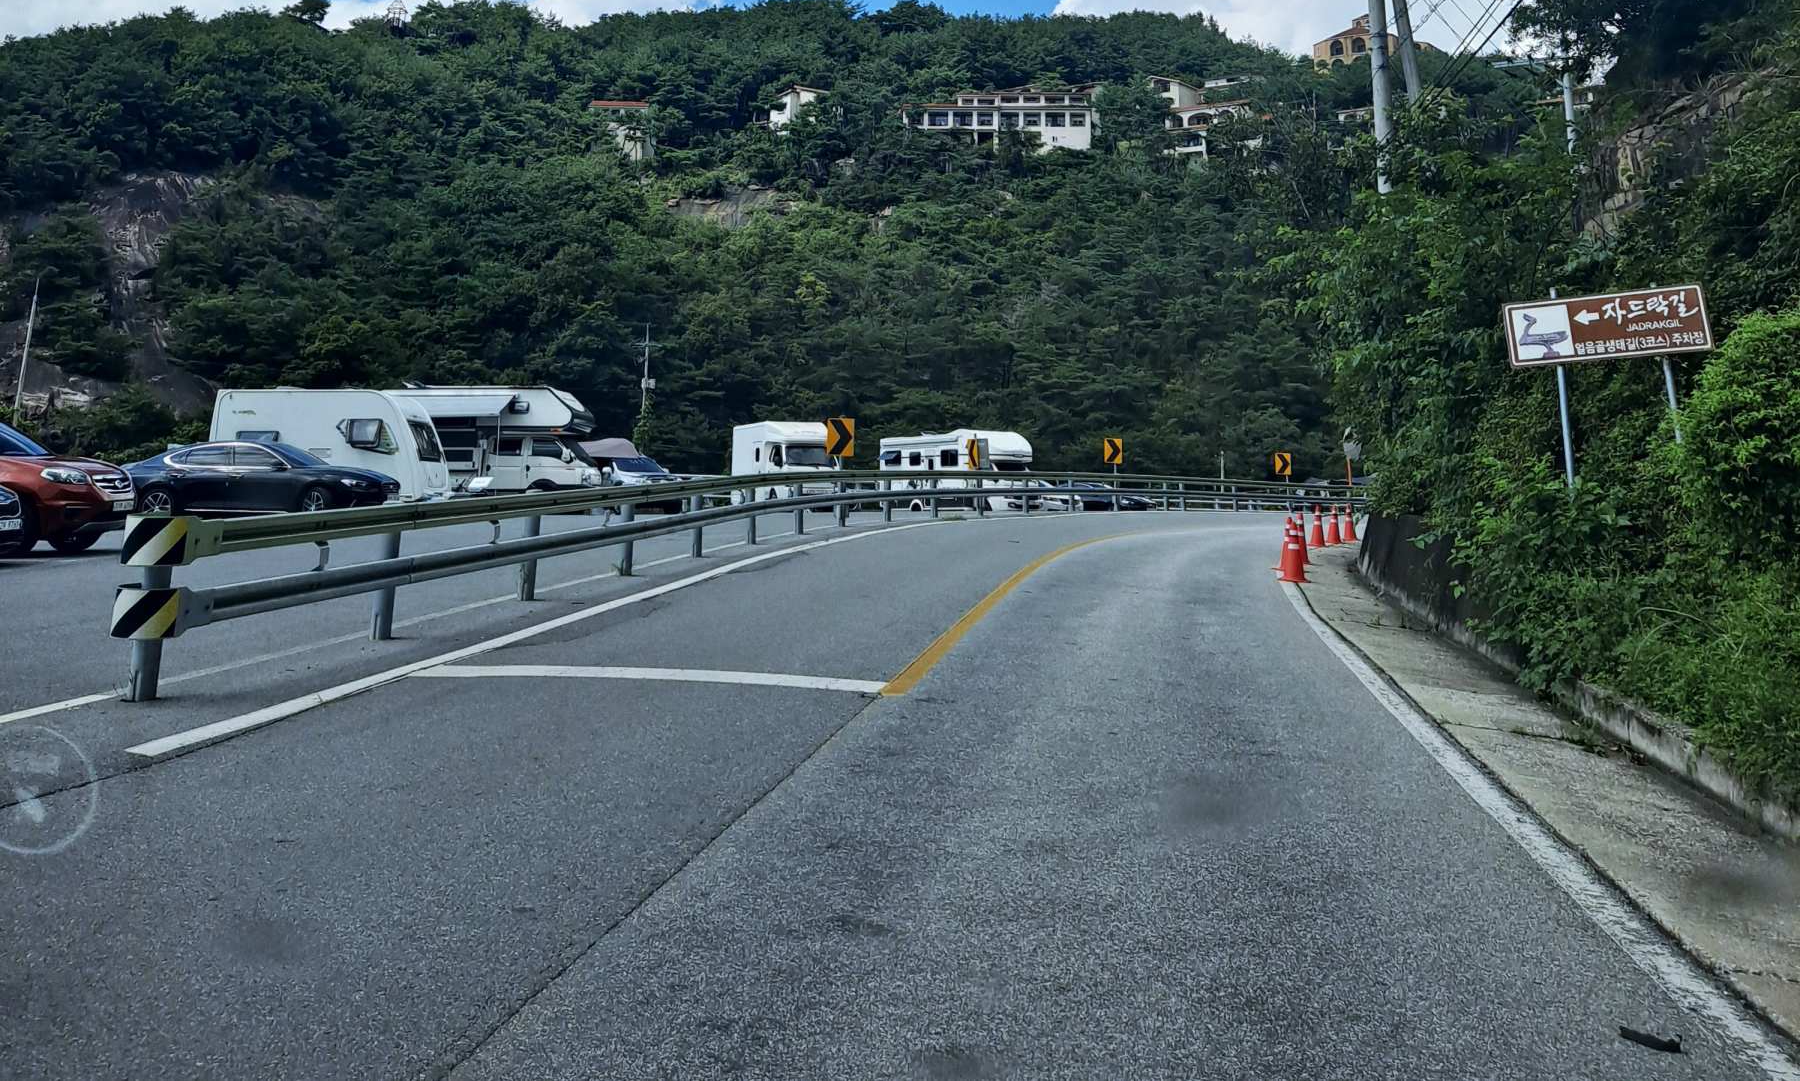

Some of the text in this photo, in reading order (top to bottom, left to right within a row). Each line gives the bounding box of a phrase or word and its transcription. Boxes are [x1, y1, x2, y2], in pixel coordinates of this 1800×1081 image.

[1602, 291, 1699, 325] 자드락길
[1626, 319, 1682, 332] JADRAKGIL
[1672, 331, 1704, 345] 주차장
